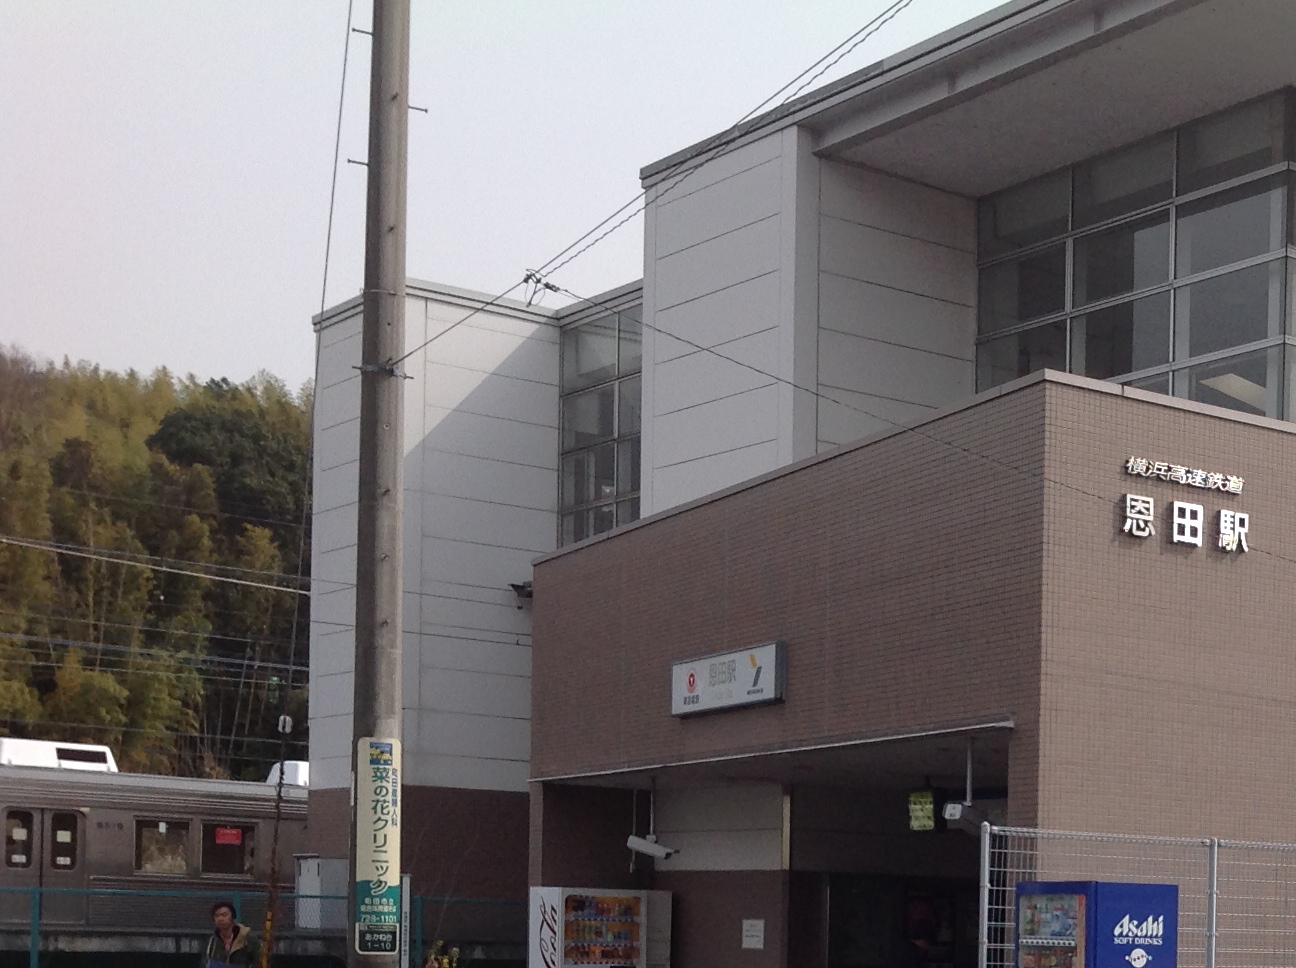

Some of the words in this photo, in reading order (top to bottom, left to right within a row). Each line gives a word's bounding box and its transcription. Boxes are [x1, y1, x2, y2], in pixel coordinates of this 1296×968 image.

[1126, 455, 1245, 494] 横浜高速鉄道
[1123, 493, 1249, 553] 恩田駅
[371, 767, 390, 895] 菜の花クリニック
[1113, 914, 1164, 937] Asahi
[1114, 937, 1133, 945] SOFT
[1135, 937, 1163, 946] DRINKS
